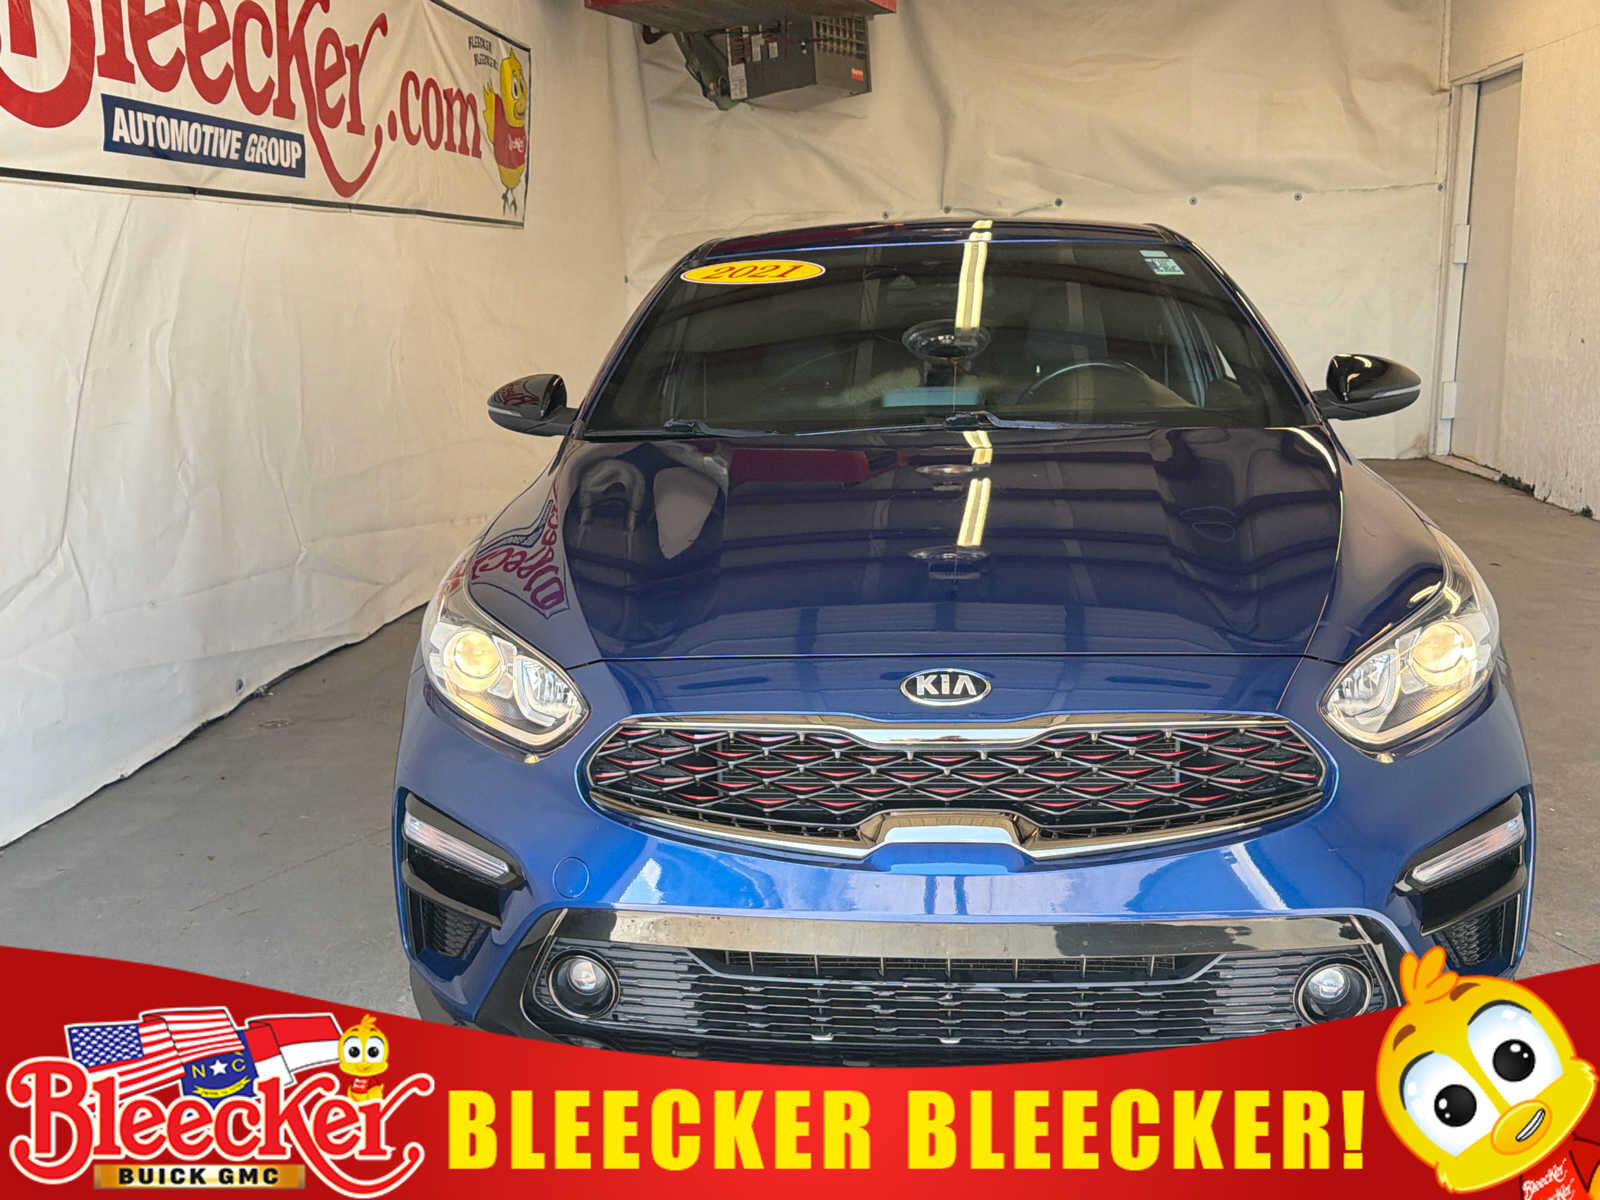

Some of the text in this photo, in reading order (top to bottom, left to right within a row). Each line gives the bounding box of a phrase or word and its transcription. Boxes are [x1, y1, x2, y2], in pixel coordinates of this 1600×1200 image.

[112, 107, 303, 169] AUTOMOTIVE GROUP
[702, 265, 804, 280] 2021
[915, 673, 977, 696] KIA
